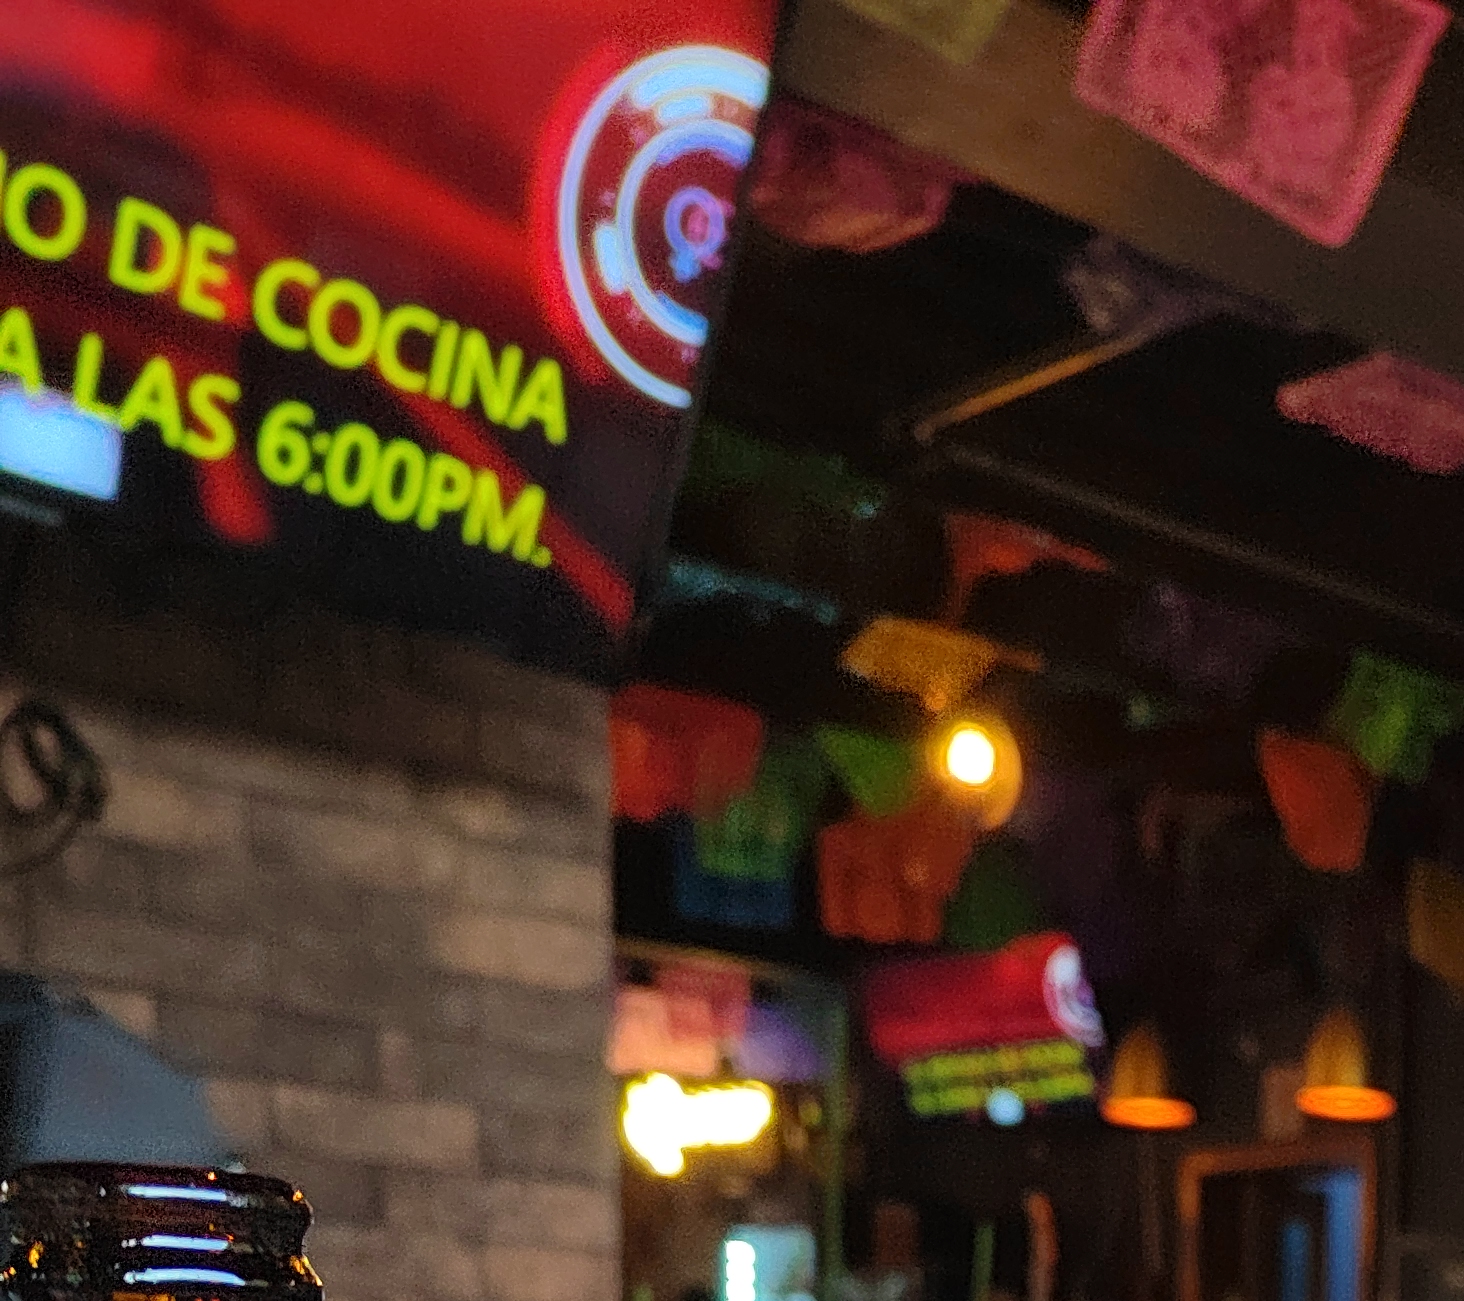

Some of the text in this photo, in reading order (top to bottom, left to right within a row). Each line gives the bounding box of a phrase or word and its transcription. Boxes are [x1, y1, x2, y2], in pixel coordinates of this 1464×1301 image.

[0, 148, 568, 445] O DE COCINA
[75, 331, 241, 460] LAS
[256, 399, 553, 568] 6:00PM.
